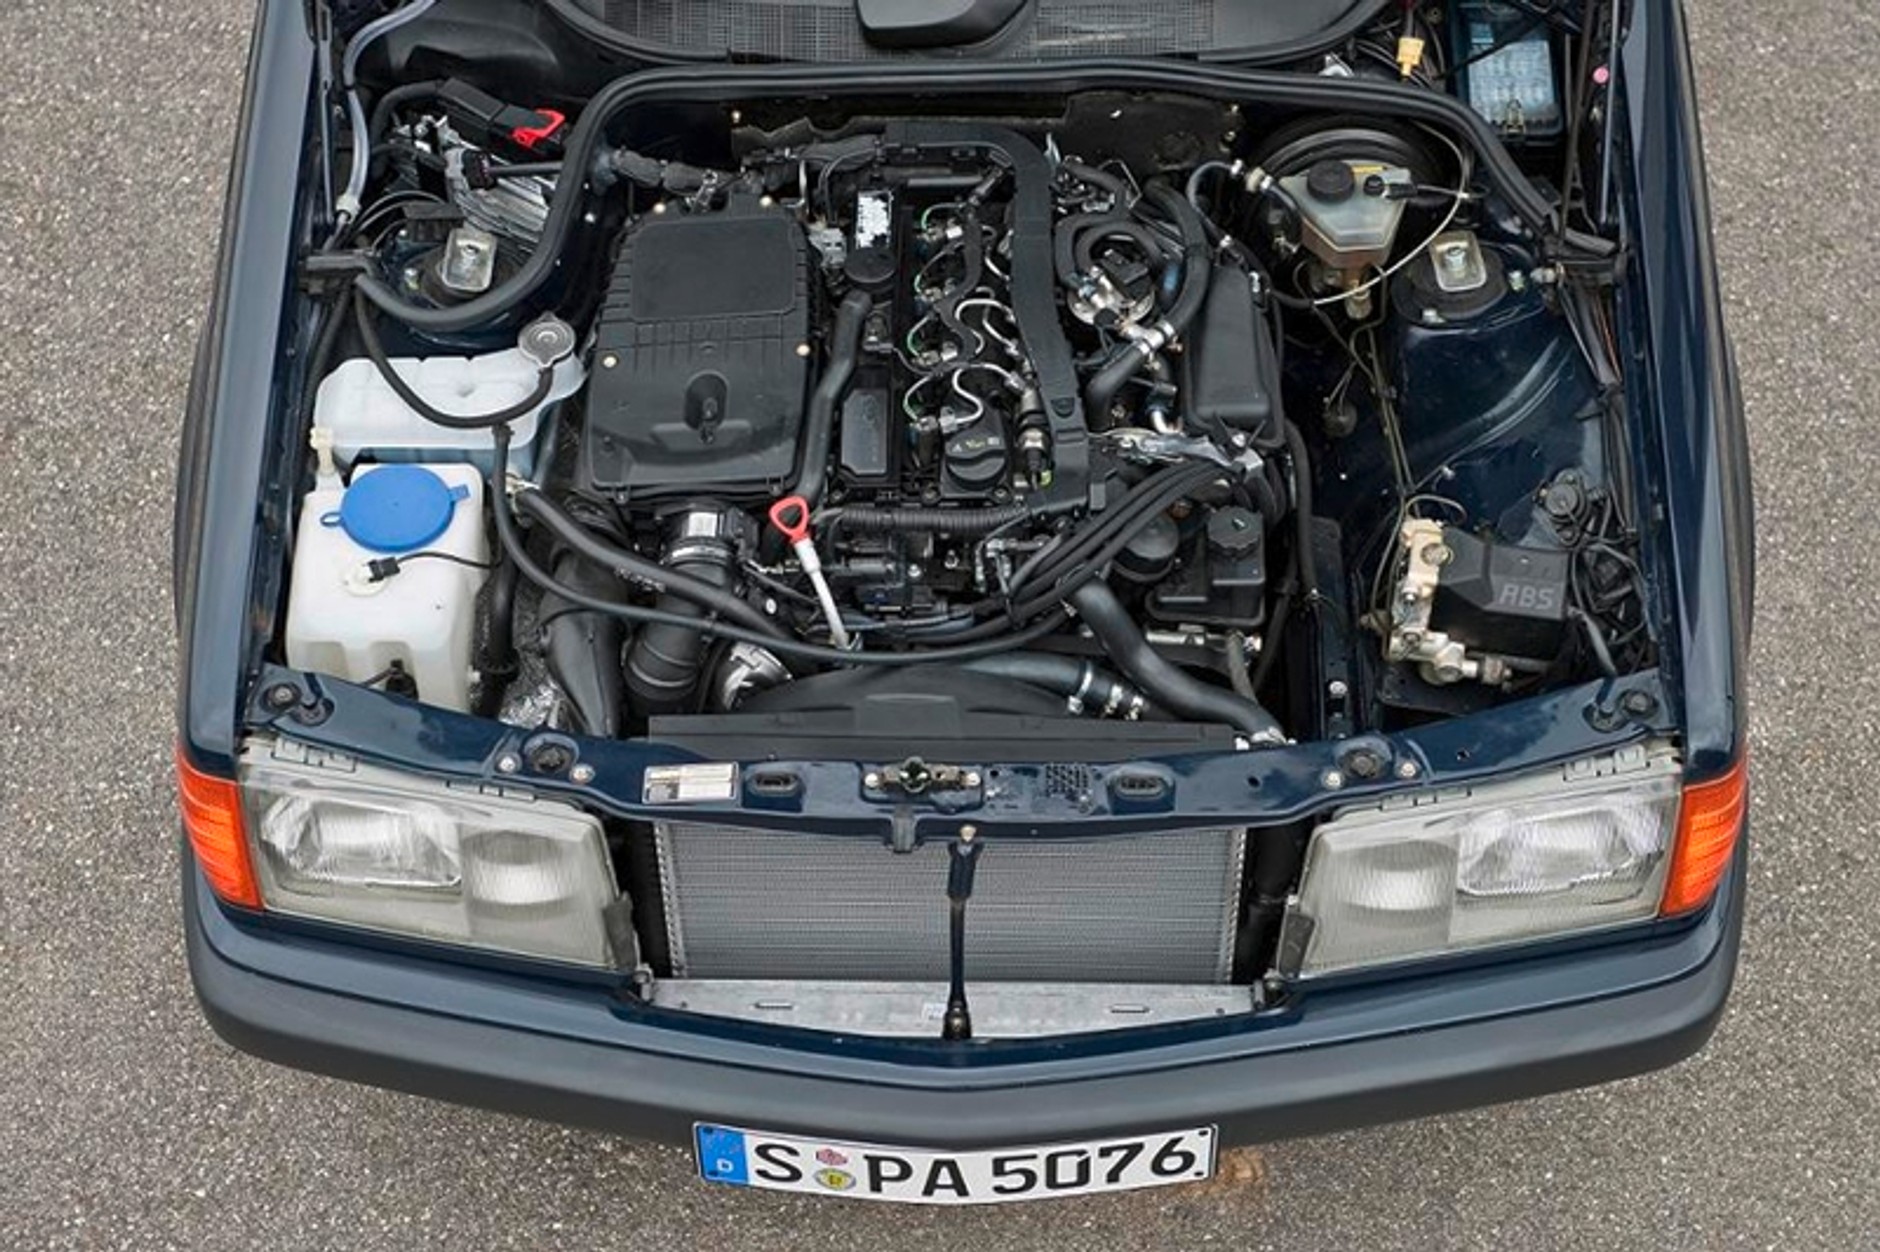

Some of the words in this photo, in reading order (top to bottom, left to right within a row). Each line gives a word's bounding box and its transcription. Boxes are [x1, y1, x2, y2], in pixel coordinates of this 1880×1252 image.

[1499, 583, 1554, 610] ABS
[716, 1158, 735, 1173] D
[754, 1143, 803, 1183] S
[863, 1154, 971, 1197] PA
[991, 1137, 1197, 1195] 5076
